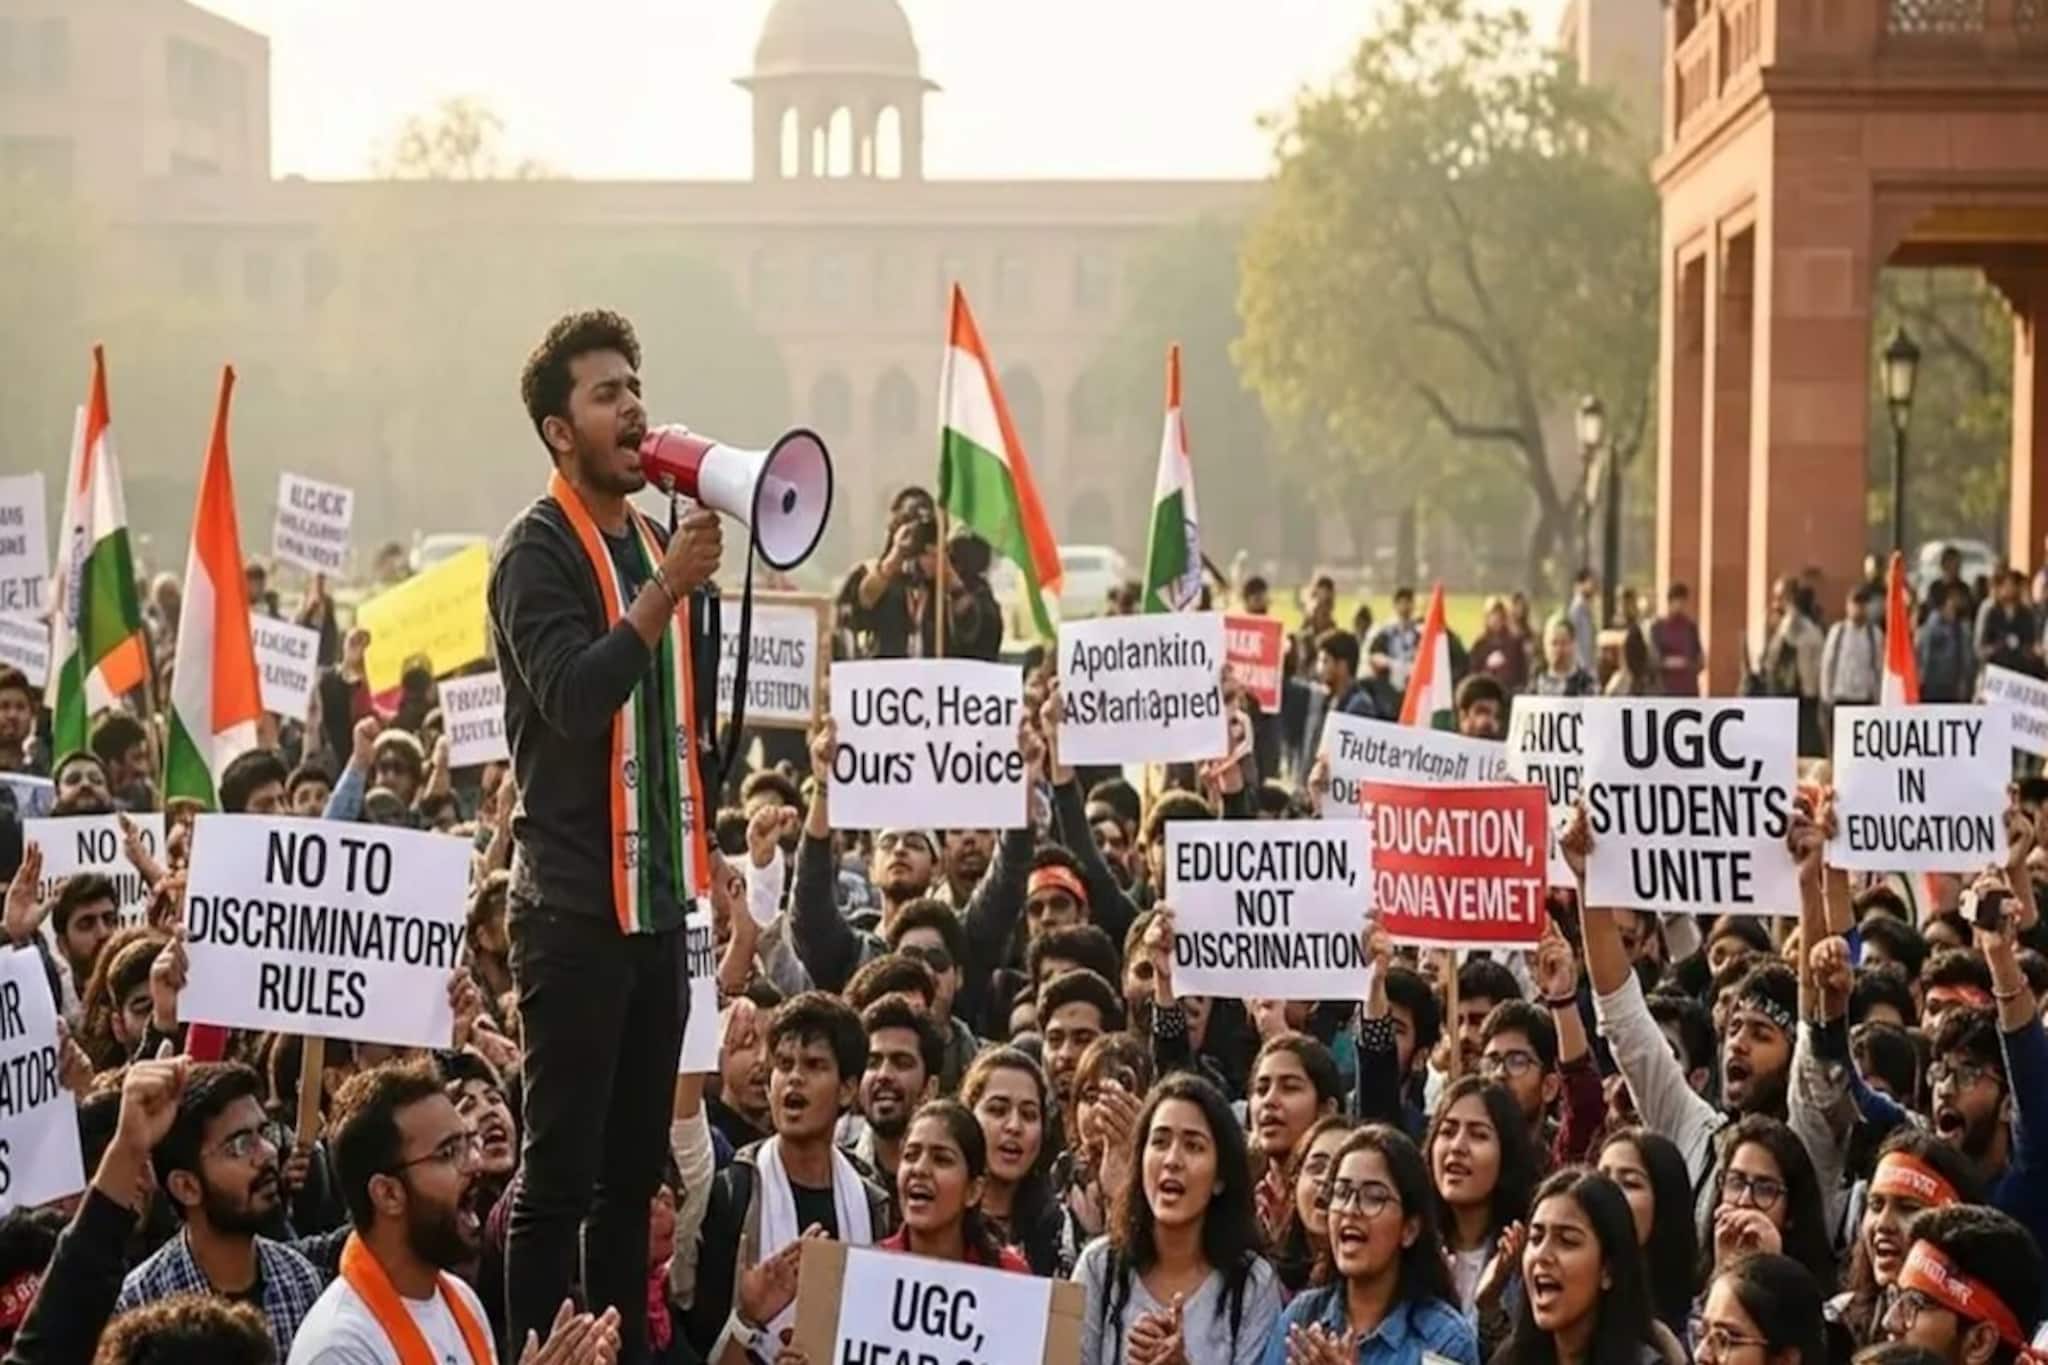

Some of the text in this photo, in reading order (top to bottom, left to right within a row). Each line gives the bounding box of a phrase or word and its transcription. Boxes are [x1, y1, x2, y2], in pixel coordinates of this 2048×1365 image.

[852, 688, 930, 729] UGC,
[937, 686, 1017, 726] Hear
[926, 741, 1024, 784] Voice
[1622, 708, 1763, 781] UGC,
[1853, 719, 1982, 762] EQUALITY
[1898, 767, 1925, 803] IN
[1589, 782, 1789, 838] STUDENTS
[77, 829, 117, 864] NO
[1848, 815, 1995, 853] EDUCATION
[265, 830, 392, 895] NO TO
[1176, 840, 1355, 887] EDUCATION,
[1632, 848, 1754, 904] UNITE
[1236, 889, 1294, 927] NOT
[188, 896, 464, 969] DISCRIMINATORY
[258, 962, 367, 1019] RULES
[892, 1278, 984, 1353] UGC,
